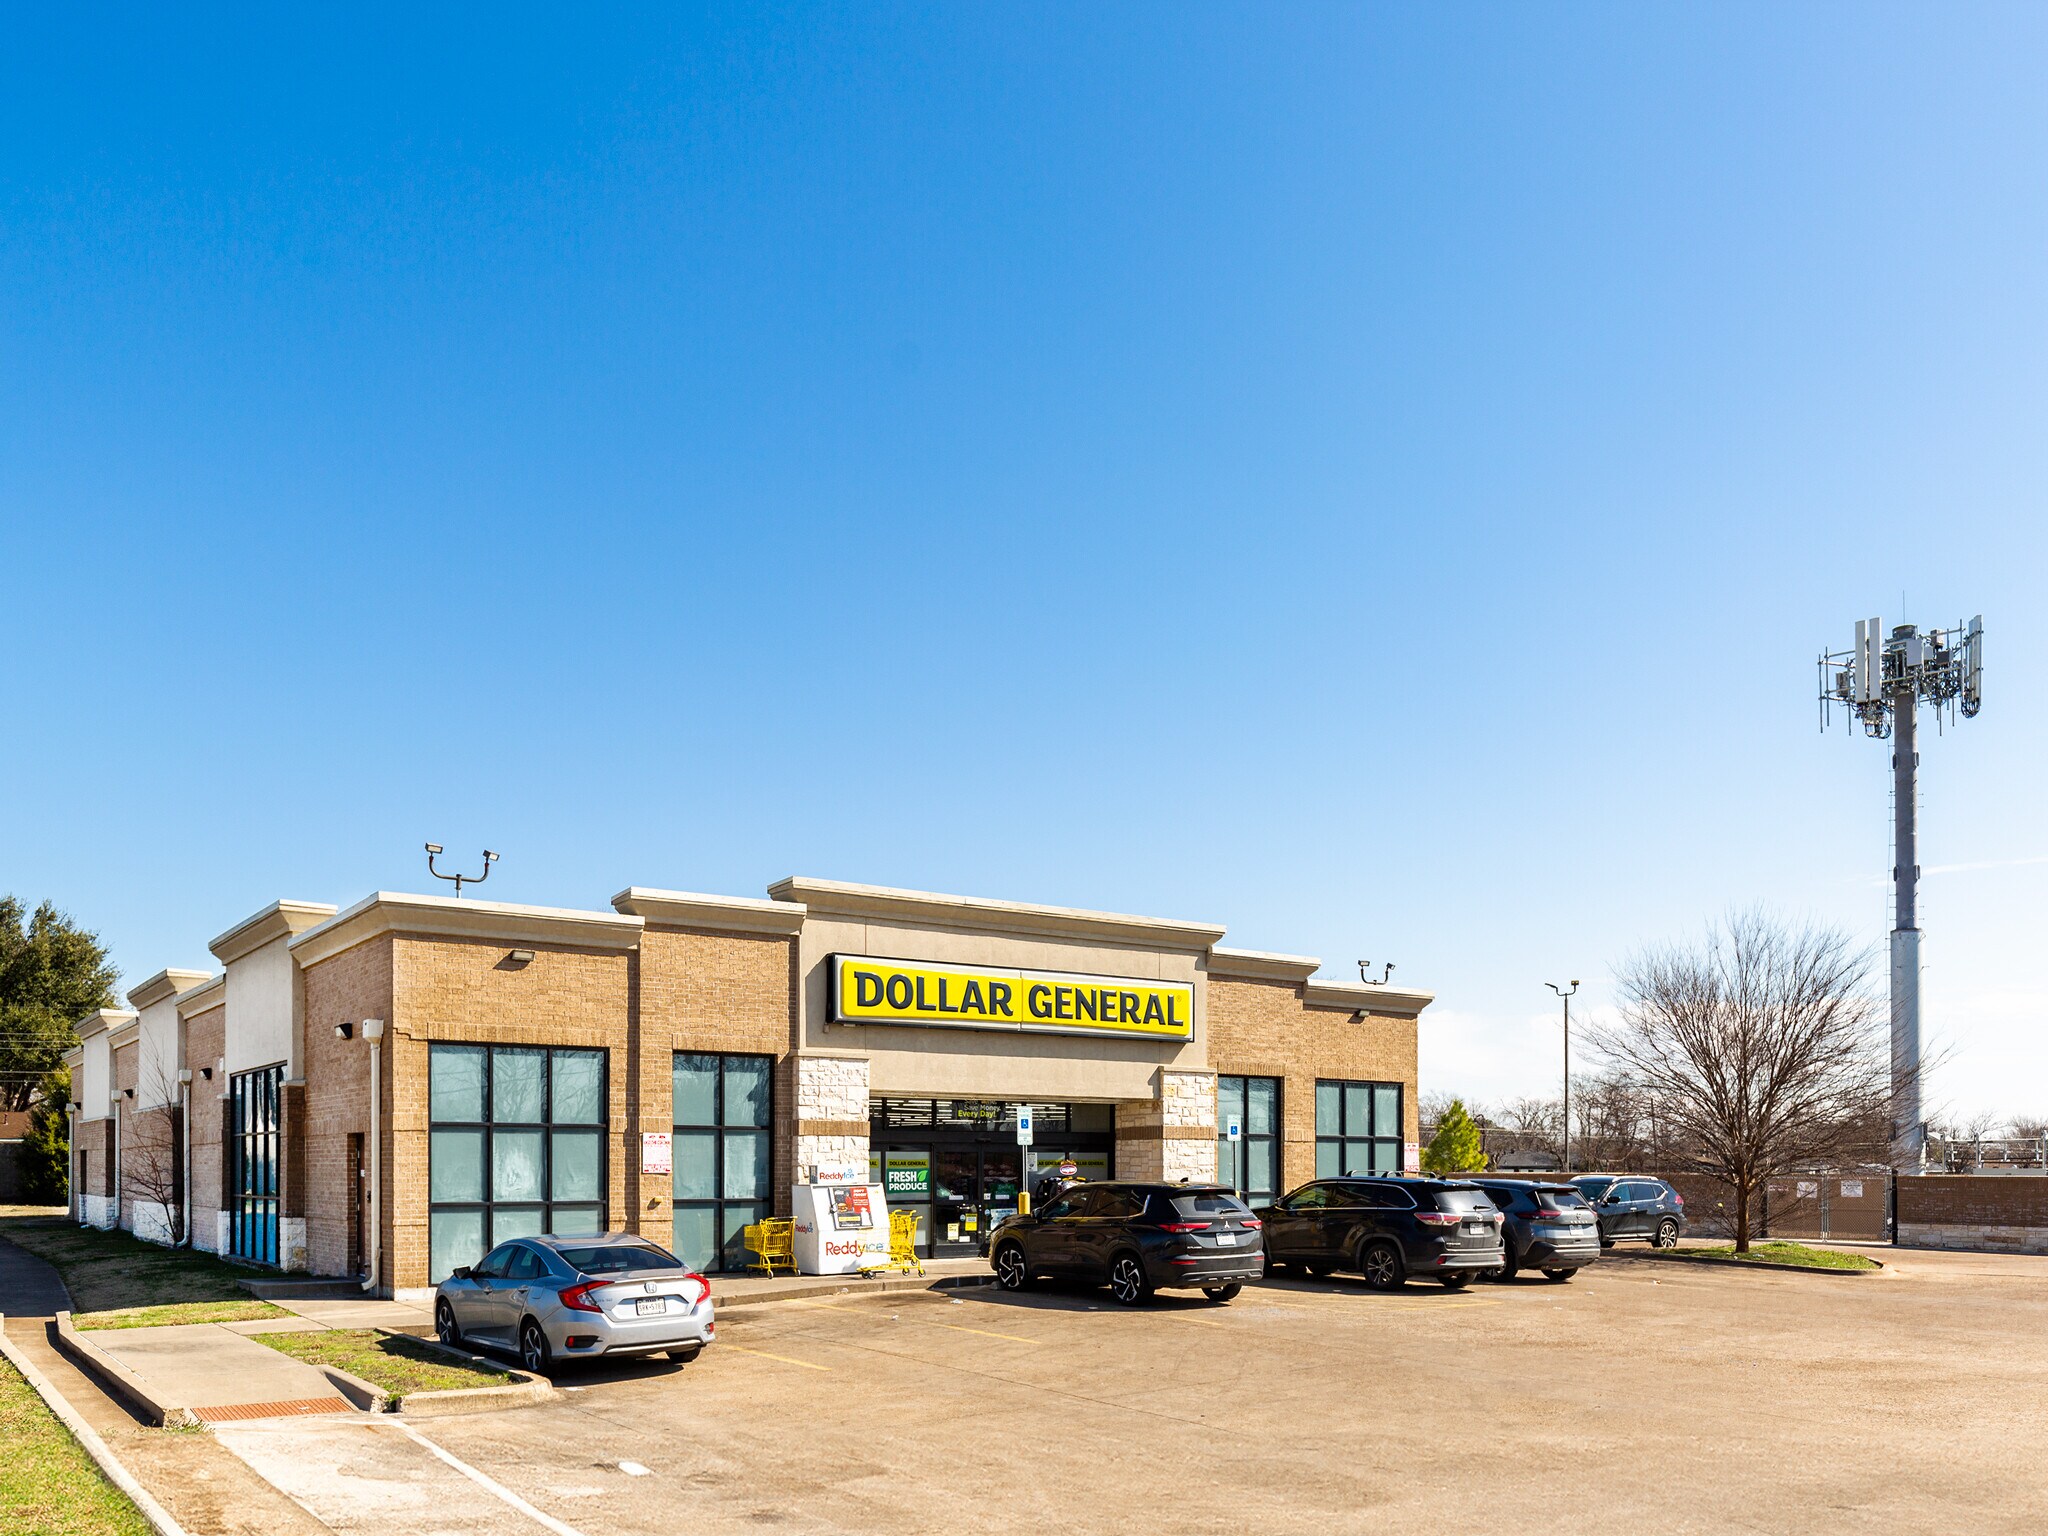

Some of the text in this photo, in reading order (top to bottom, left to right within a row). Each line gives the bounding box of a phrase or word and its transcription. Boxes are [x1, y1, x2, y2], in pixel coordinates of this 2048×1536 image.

[853, 971, 1185, 1027] DOLLAR GENERAL
[957, 1109, 979, 1118] Every
[888, 1171, 917, 1182] FRESH
[888, 1182, 928, 1191] PRODUCE
